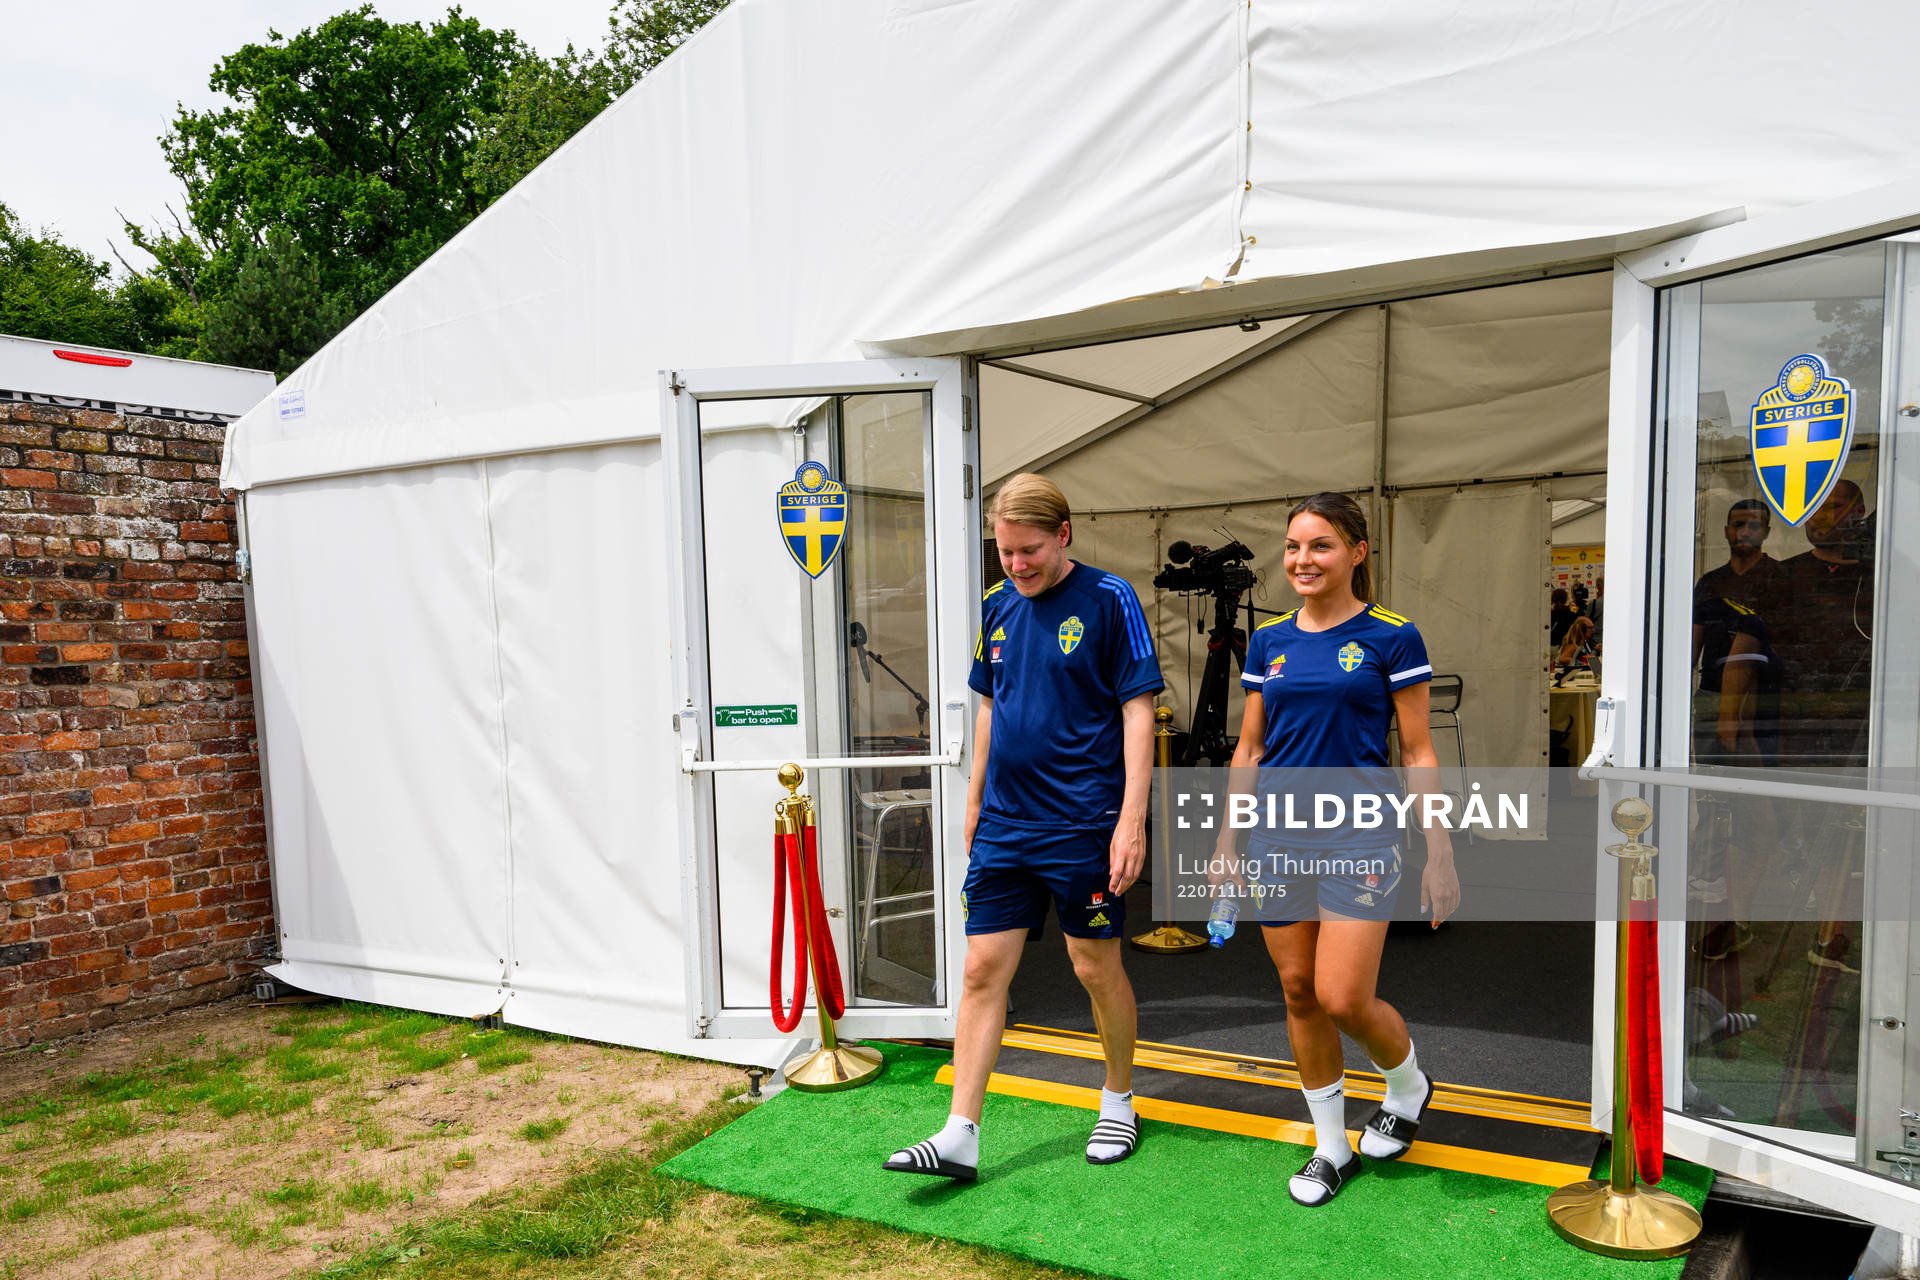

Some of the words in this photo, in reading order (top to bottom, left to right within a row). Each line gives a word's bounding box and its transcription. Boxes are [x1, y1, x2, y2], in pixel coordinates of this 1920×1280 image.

[1765, 401, 1834, 422] SVERIGE
[787, 495, 838, 506] SVERIGE
[745, 708, 768, 716] Push
[759, 717, 782, 725] open
